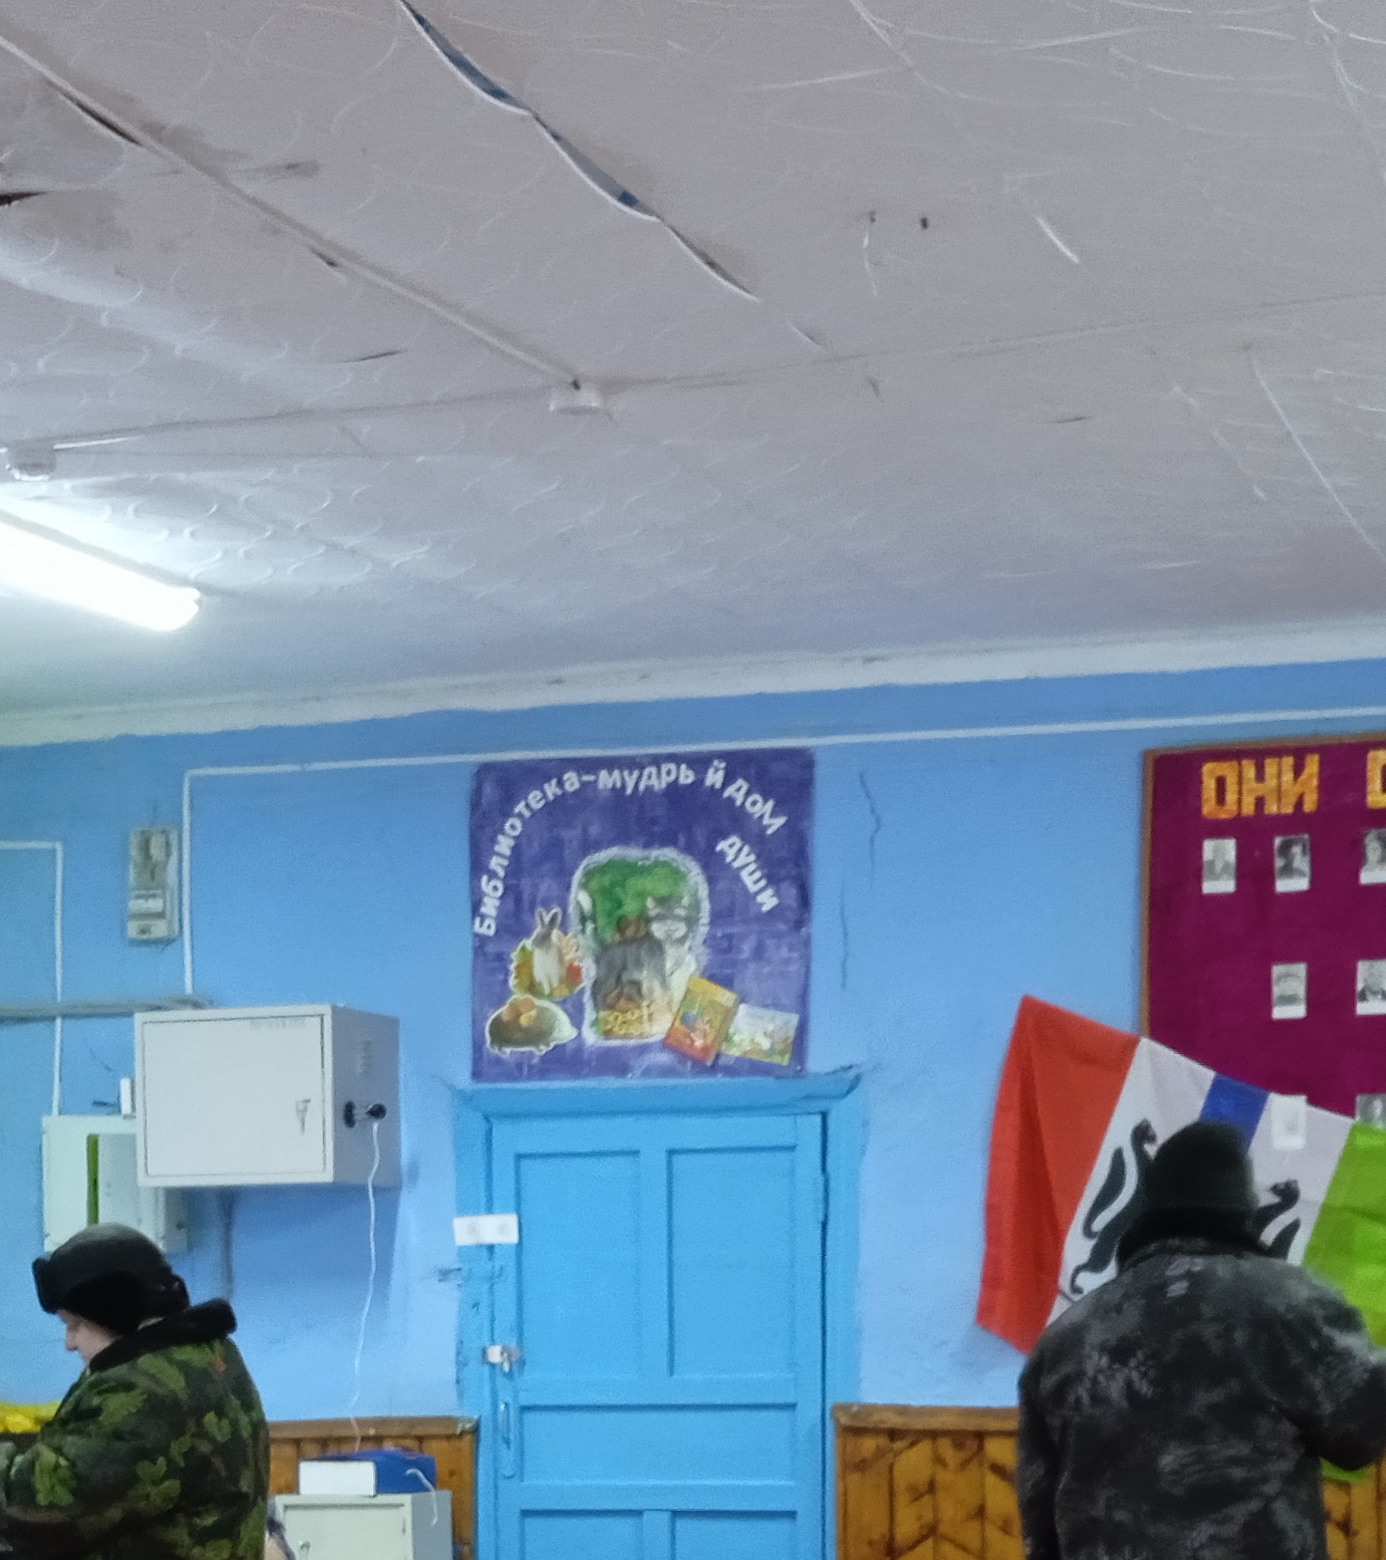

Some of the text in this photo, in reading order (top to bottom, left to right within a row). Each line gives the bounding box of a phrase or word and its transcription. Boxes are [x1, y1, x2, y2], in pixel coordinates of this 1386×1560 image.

[722, 777, 788, 836] дом
[1201, 753, 1321, 819] ОНИ
[714, 834, 780, 913] души
